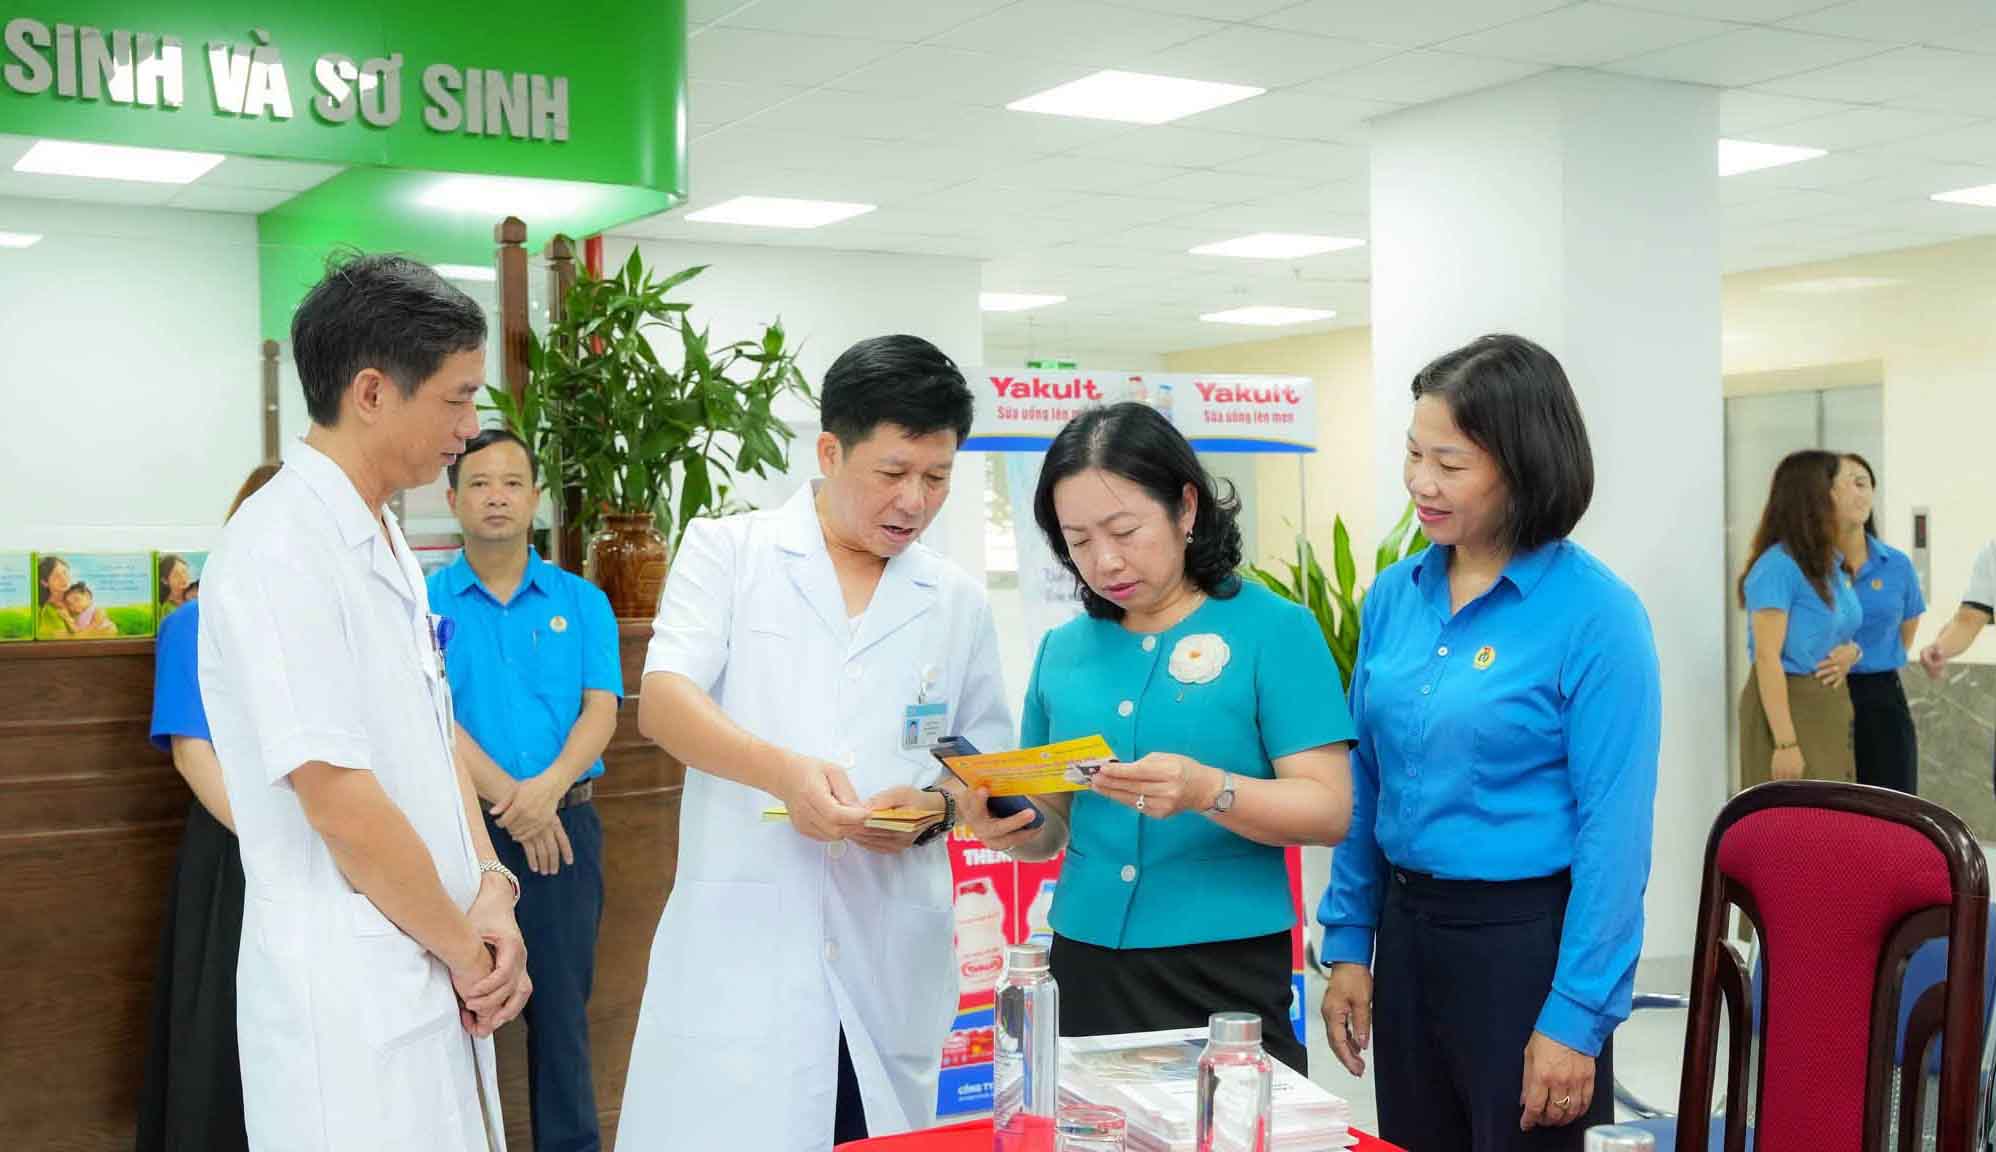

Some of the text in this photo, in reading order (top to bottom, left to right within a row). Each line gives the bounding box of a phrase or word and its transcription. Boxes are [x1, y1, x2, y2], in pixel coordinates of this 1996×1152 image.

[3, 18, 569, 142] SINH VÀ SƠ SINH
[990, 376, 1104, 401] Yakult
[1193, 381, 1301, 405] Yakult
